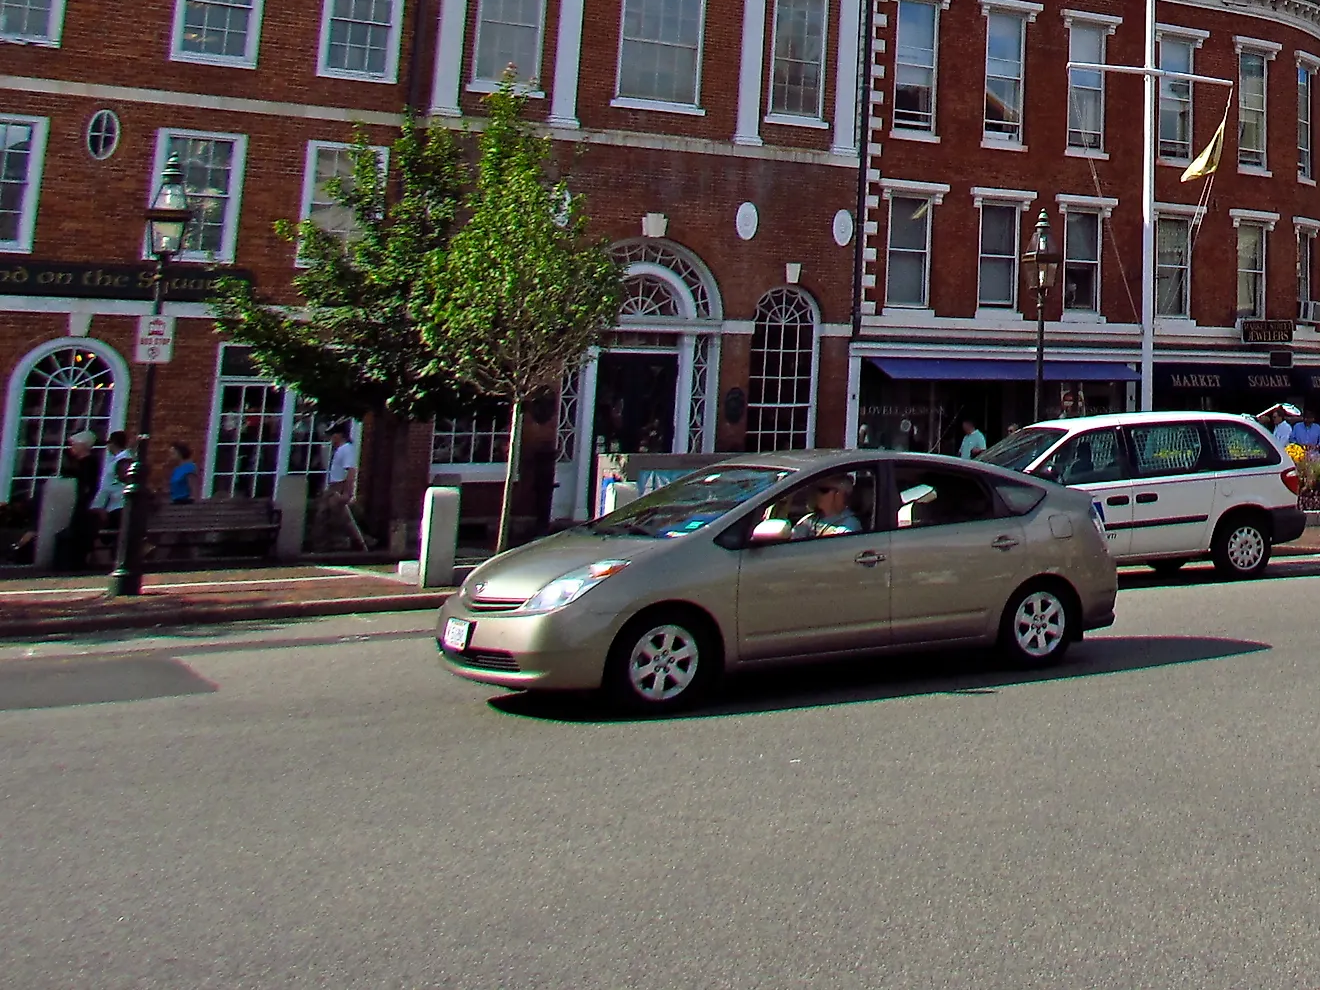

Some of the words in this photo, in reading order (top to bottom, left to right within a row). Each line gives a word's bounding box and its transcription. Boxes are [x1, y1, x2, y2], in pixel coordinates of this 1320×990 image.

[37, 270, 73, 285] on
[81, 269, 129, 288] the
[1247, 330, 1289, 342] JEWELERS
[1171, 374, 1221, 387] MARKET
[1248, 375, 1291, 387] SQUARE
